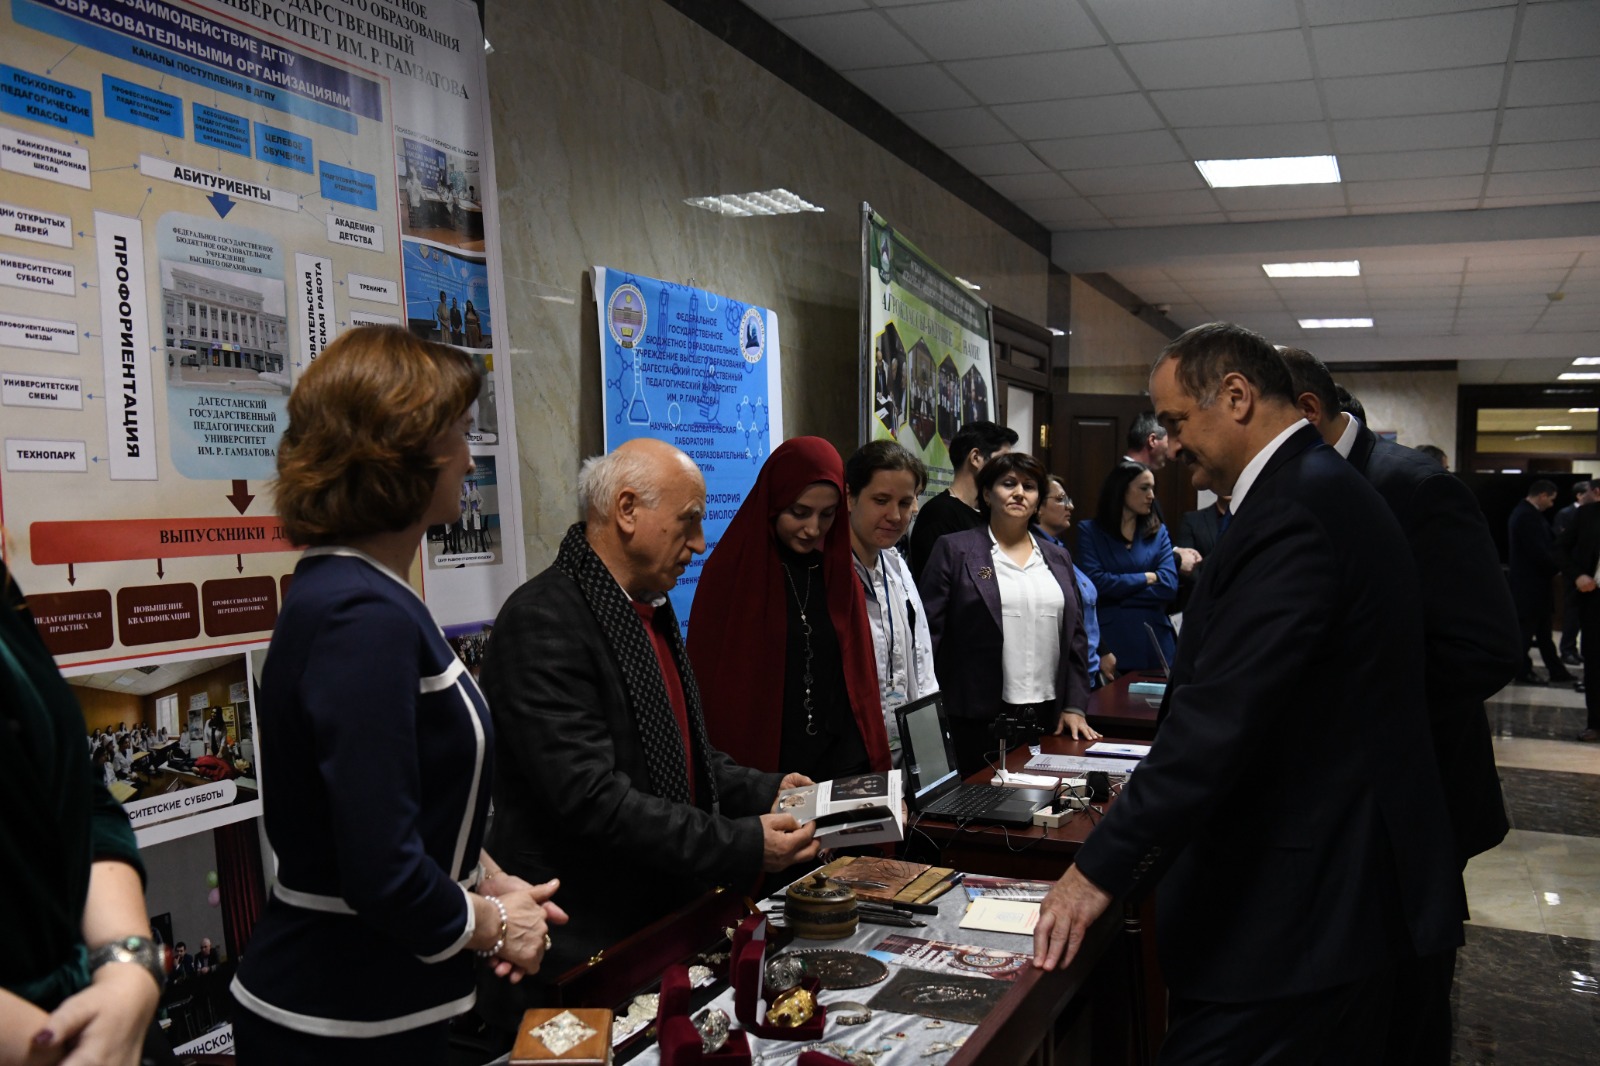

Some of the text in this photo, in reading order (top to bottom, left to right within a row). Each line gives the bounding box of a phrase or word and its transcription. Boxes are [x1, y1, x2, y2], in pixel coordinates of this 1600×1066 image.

[386, 0, 429, 20] ТНОЕ
[121, 0, 295, 67] ЗАИМОДЕЙСТВИЕ ДГПУ
[280, 0, 416, 56] ДАРСТВЕННЫЙ
[370, 3, 460, 52] ОБРАЗОВАНИЯ
[132, 46, 276, 102] КАНАЛЫ ПОСТУПЛЕНИЯ В ДГПУ
[336, 34, 367, 60] ИМ.
[370, 46, 382, 66] Р.
[385, 52, 470, 100] ГАМЗАТОВА
[13, 73, 76, 99] ПСИХОЛОГО-
[237, 57, 351, 108] ОРГАНИЗАЦИЯМИ
[1, 84, 90, 116] ПЕДАГОГИЧЕСКИЕ
[26, 105, 68, 125] КЛАССЫ
[16, 138, 72, 158] КАНИКУЛЯРНАЯ
[264, 132, 303, 150] ЦЕЛЕВОЕ
[1, 144, 87, 171] ПРОФОРИЕНТАЦИОННАЯ
[263, 145, 306, 164] ОБУЧЕНИЕ
[33, 162, 58, 174] ШКОЛА
[174, 166, 271, 201] АБИТУРИЕНТЫ
[17, 211, 65, 228] ОТКРЫТЫХ
[335, 218, 375, 233] АКАДЕМИЯ
[15, 223, 49, 236] ДВЕРЕЙ
[339, 231, 373, 245] ДЕТСТВА
[172, 227, 273, 253] ФЕДЕРАЛЬНОЕ ГОСУДАРСТВЕННОЕ
[176, 236, 272, 260] БЮДЖЕТНОЕ ОБРАЗОВАТЕЛЬНОЕ
[189, 255, 220, 266] ВЫСШЕГО
[205, 250, 245, 263] УЧРЕЖДЕНИЕ
[0, 259, 72, 277] НИВЕРСИТЕТСКИЕ
[16, 273, 54, 285] СУББОТЫ
[315, 262, 325, 309] РАБОТА
[360, 283, 387, 293] ТРЕНИНГИ
[305, 271, 317, 363] ОВАТЕЛЬСКАЯ
[676, 312, 717, 327] ФЕДЕРАЛЬНОЕ
[25, 332, 53, 341] ВЫЕЗДЫ
[668, 324, 723, 341] ГОСУДАРСТВЕННОЕ
[114, 235, 140, 457] ПРОФОРИЕНТАЦИЯ
[646, 335, 739, 356] БЮДЖЕТНОЕ ОБРАЗОВАТЕЛЬНОЕ
[635, 348, 746, 369] УЧРЕЖДЕНИЕ ВЫСШЕГО ОБРАЗОВАНИЯ
[691, 367, 743, 382] ГОСУДАРСТВЕННЫЙ
[3, 378, 79, 392] УНИВЕРСИТЕТСКИЕ
[645, 376, 737, 394] ПЕДАГОГИЧЕСКИЙ УНИВЕРСИТЕТ
[28, 392, 58, 400] СМЕНЫ
[198, 396, 267, 409] ДАГЕСТАНСКИЙ
[667, 392, 678, 402] ИМ.
[189, 408, 276, 422] ГОСУДАРСТВЕННЫЙ
[194, 421, 275, 433] ПЕДАГОГИЧЕСКИЙ
[650, 421, 737, 434] НАУЧНО-ИССЛЕДОВАТЕЛЬСКАЯ
[204, 433, 266, 445] УНИВЕРСИТЕТ
[674, 436, 714, 446] ЛАБОРАТОРИЯ
[17, 449, 76, 460] ТЕХНОПАРК
[198, 446, 275, 457] ИМ. Р. ГАМЗАТОВА
[696, 450, 748, 460] ОБРАЗОВАТЕЛЬНЫЕ
[705, 493, 741, 504] ОРАТОРИЯ
[159, 526, 265, 544] ВЫПУСКНИКИ
[133, 602, 183, 613] ПОВЫШЕНИЕ
[128, 611, 190, 625] КВАЛИФИКАЦИИ
[50, 623, 89, 633] ПРАКТИКА
[127, 789, 224, 820] СИТЕТСКИЕ СУББОТЫ
